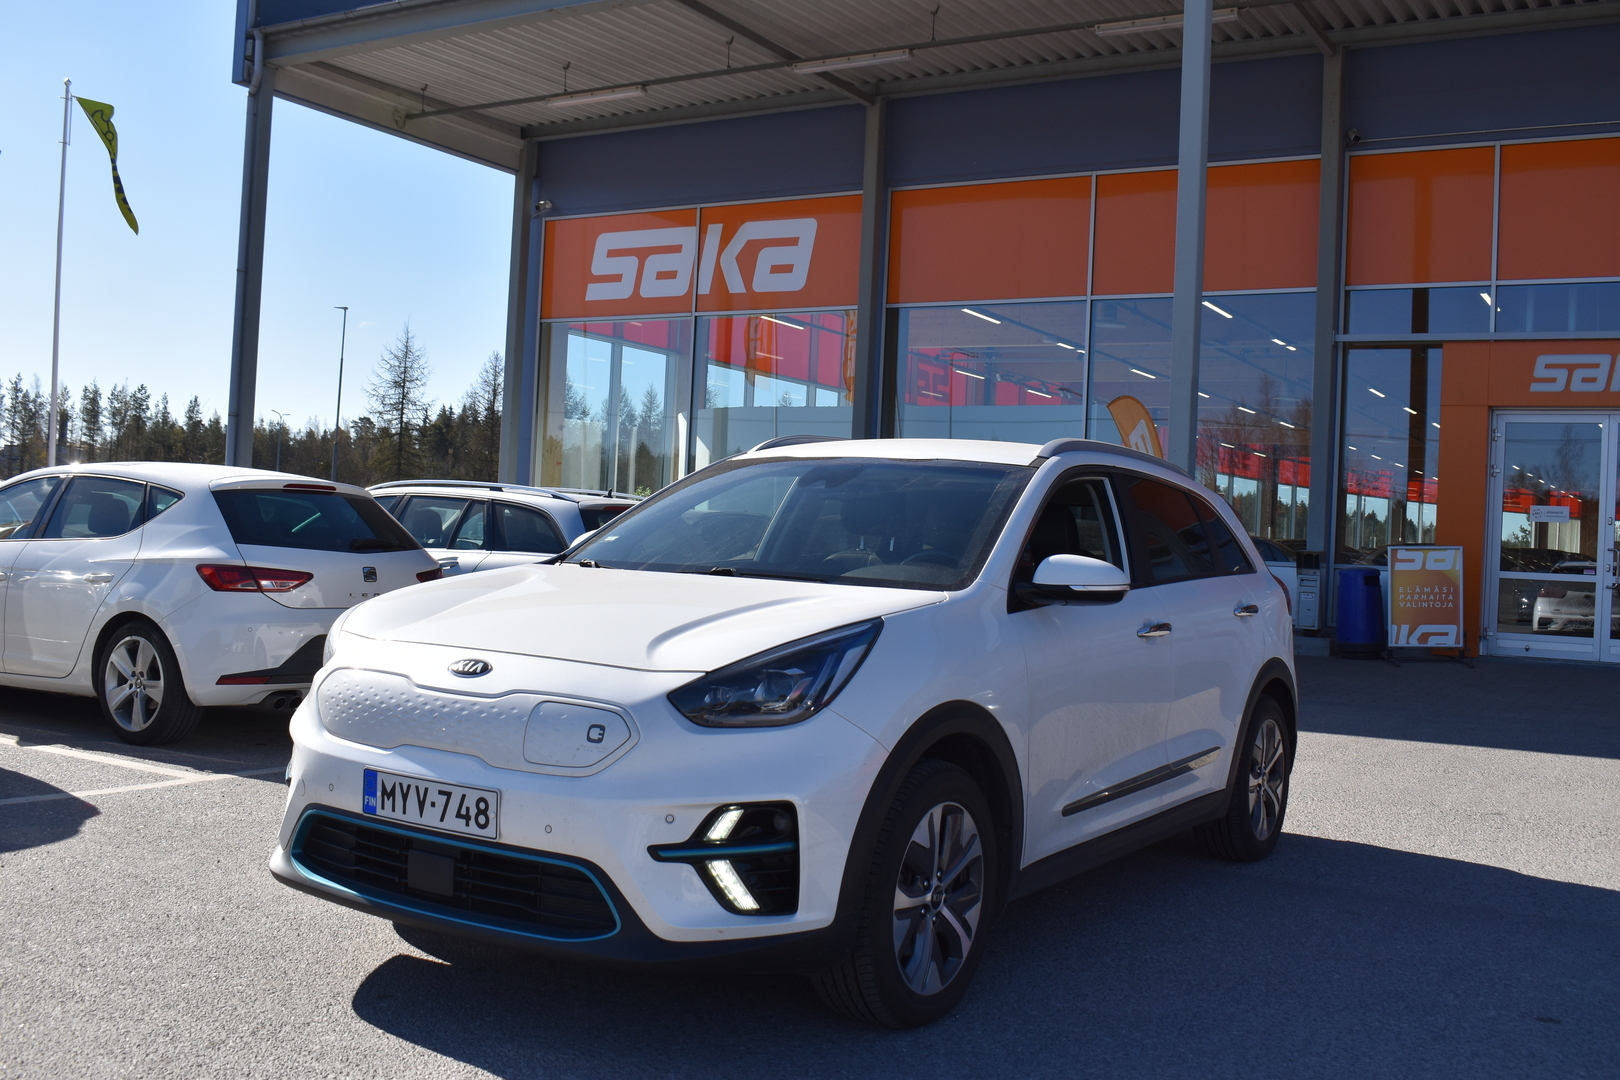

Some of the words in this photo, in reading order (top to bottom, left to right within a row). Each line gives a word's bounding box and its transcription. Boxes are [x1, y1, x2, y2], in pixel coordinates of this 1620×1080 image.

[1529, 354, 1620, 392] sa
[1398, 585, 1454, 593] ELÄMÄSI
[450, 660, 485, 673] KIA
[364, 796, 377, 807] FIN
[381, 779, 490, 830] MYV-748
